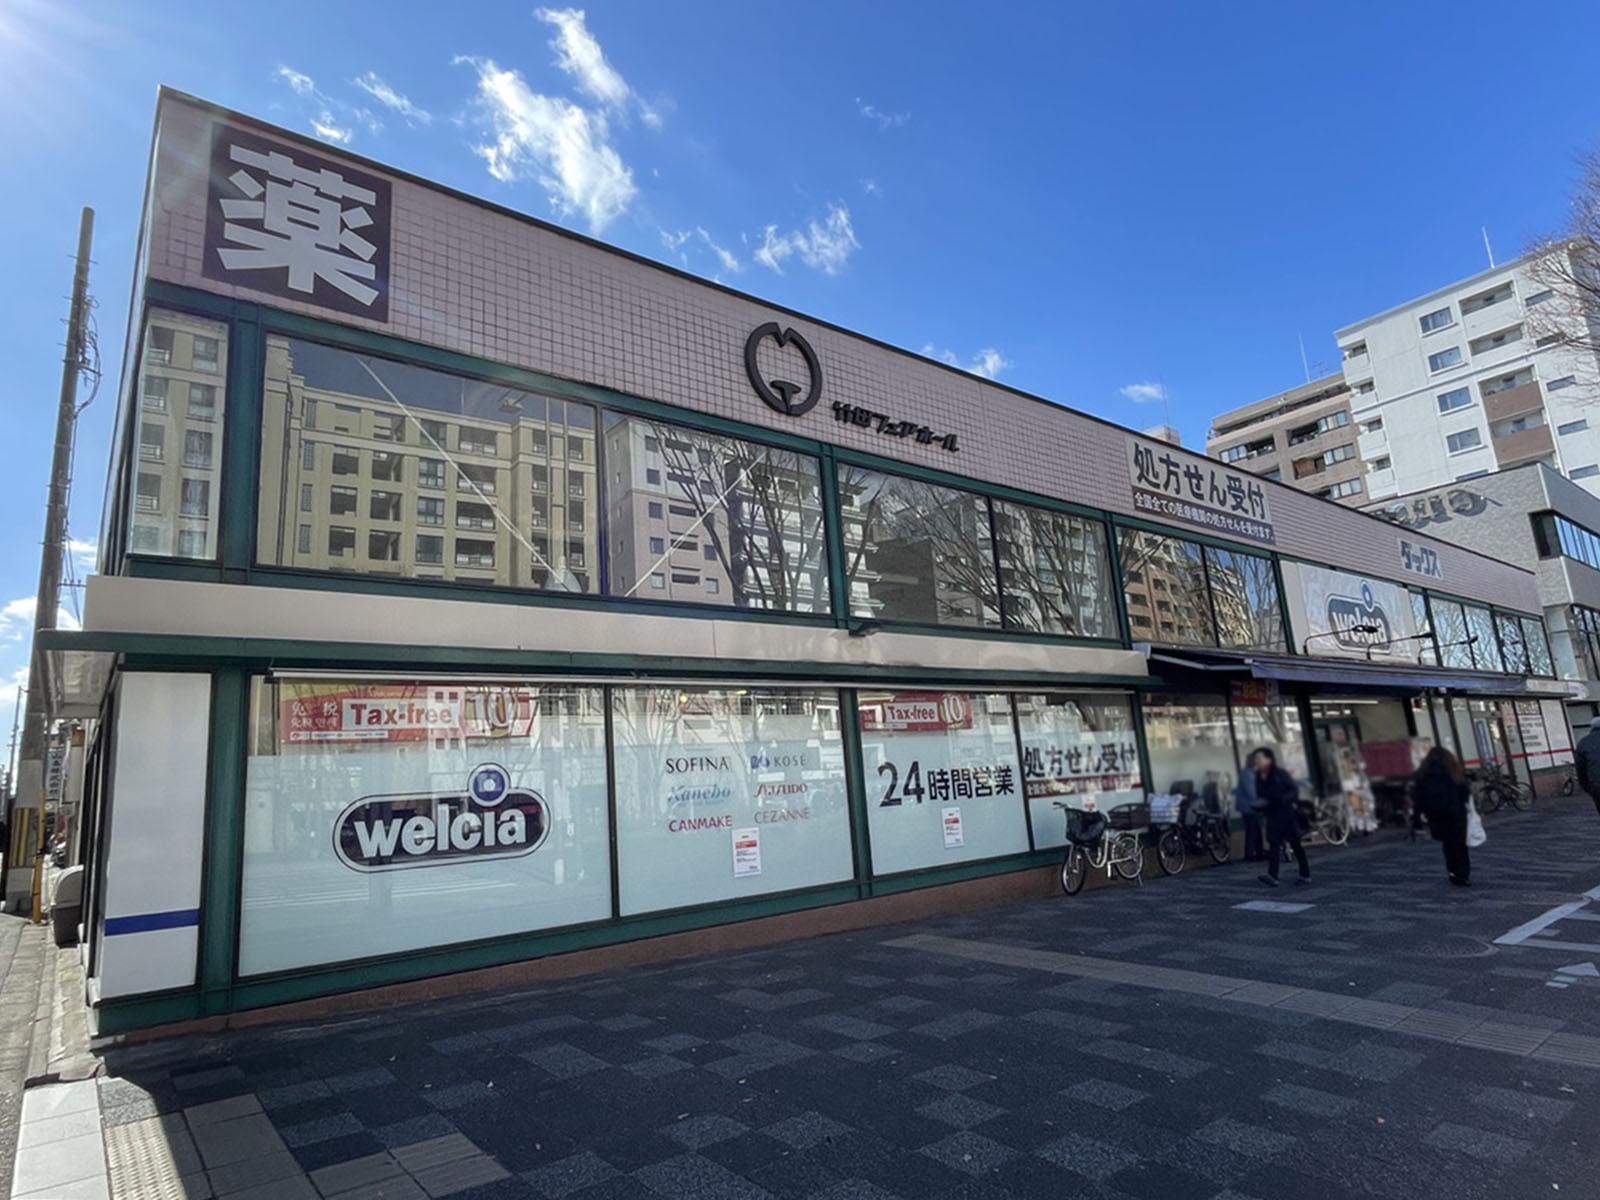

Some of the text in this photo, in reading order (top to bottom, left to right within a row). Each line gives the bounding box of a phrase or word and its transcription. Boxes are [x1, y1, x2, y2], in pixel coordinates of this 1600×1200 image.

[216, 143, 380, 307] 薬
[1132, 441, 1265, 520] 処方せん受付
[1400, 540, 1442, 577] ダックス
[351, 703, 452, 726] Tax-free
[887, 705, 935, 720] Tax-free
[942, 694, 963, 723] 10
[665, 756, 729, 774] SOFINA
[1023, 742, 1136, 778] 処方せん受付
[667, 784, 732, 803] Kanebo
[668, 815, 733, 832] CANMAKE
[754, 807, 811, 825] CEZANNE
[354, 803, 528, 859] welcia
